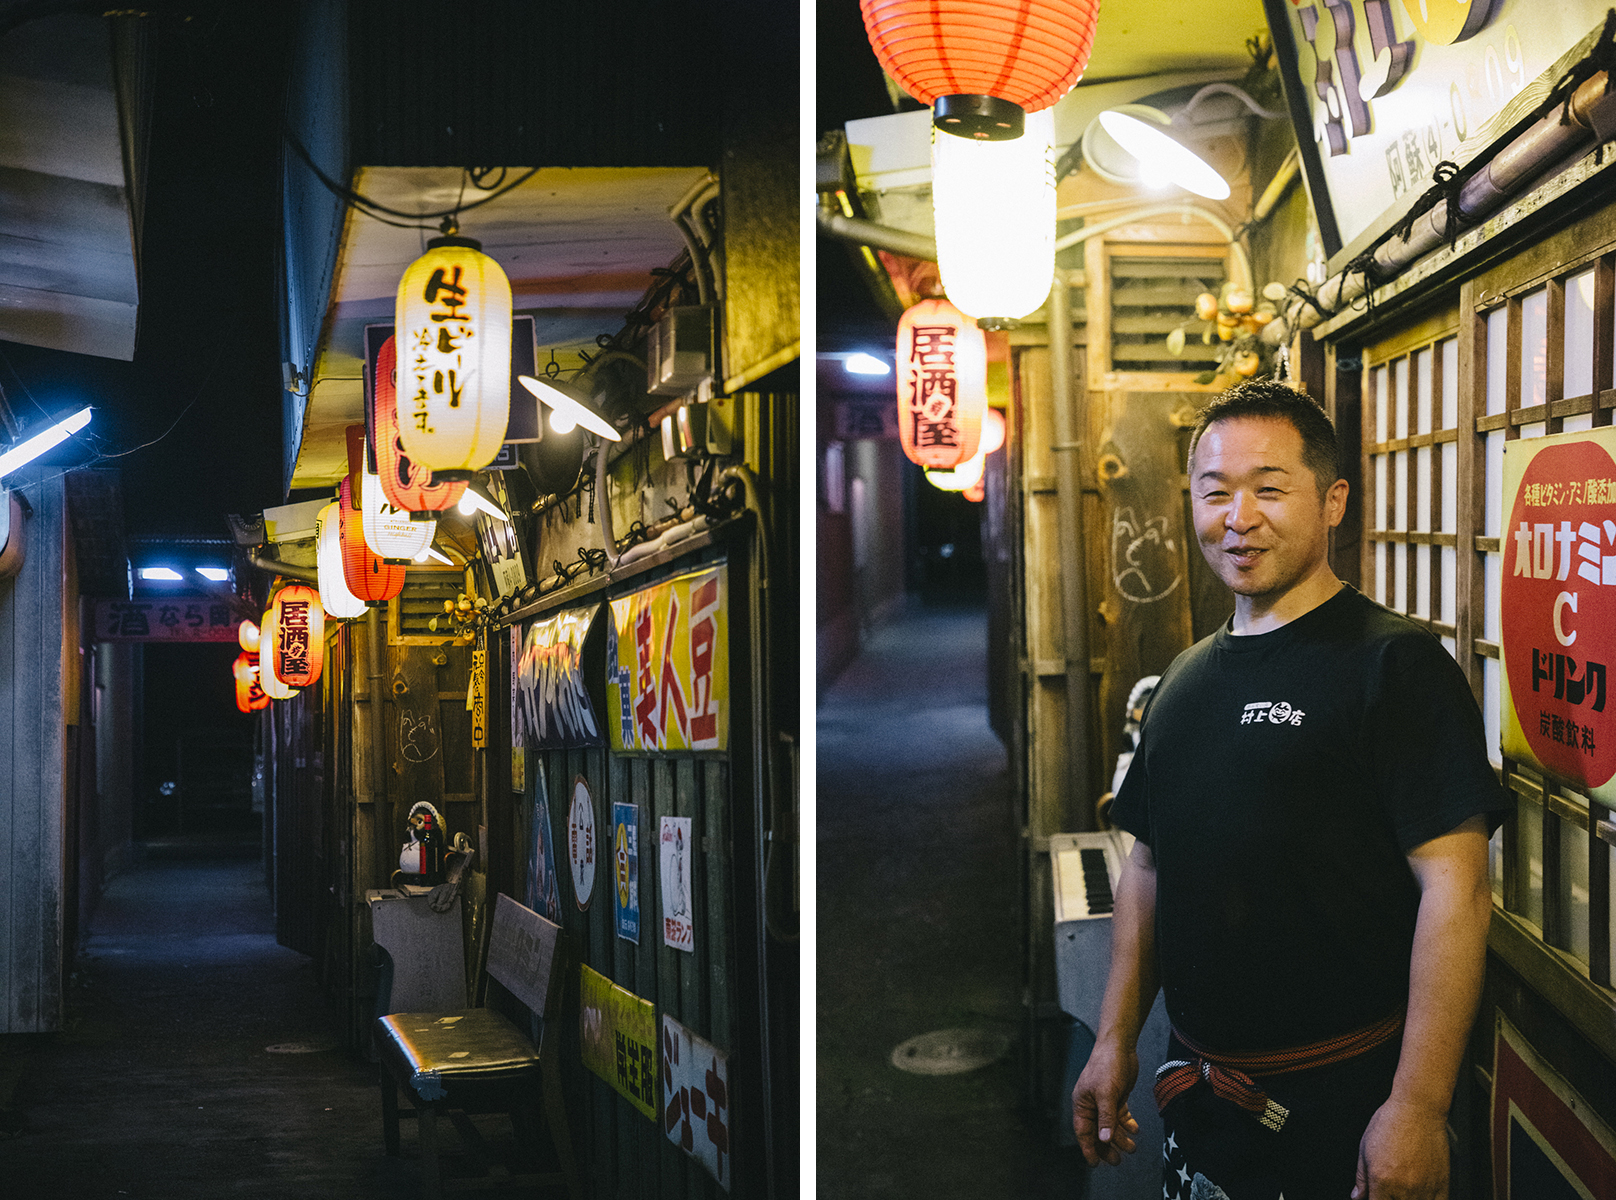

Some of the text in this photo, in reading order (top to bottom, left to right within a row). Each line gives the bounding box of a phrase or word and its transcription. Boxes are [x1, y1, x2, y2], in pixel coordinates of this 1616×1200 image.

[424, 266, 475, 408] 生ビール
[384, 524, 417, 532] GINGER
[1513, 519, 1616, 586] オロナミン
[279, 601, 310, 675] 居酒屋
[1552, 590, 1578, 647] C
[1532, 648, 1606, 713] ドリンク
[1539, 711, 1596, 757] 炭酸飲料
